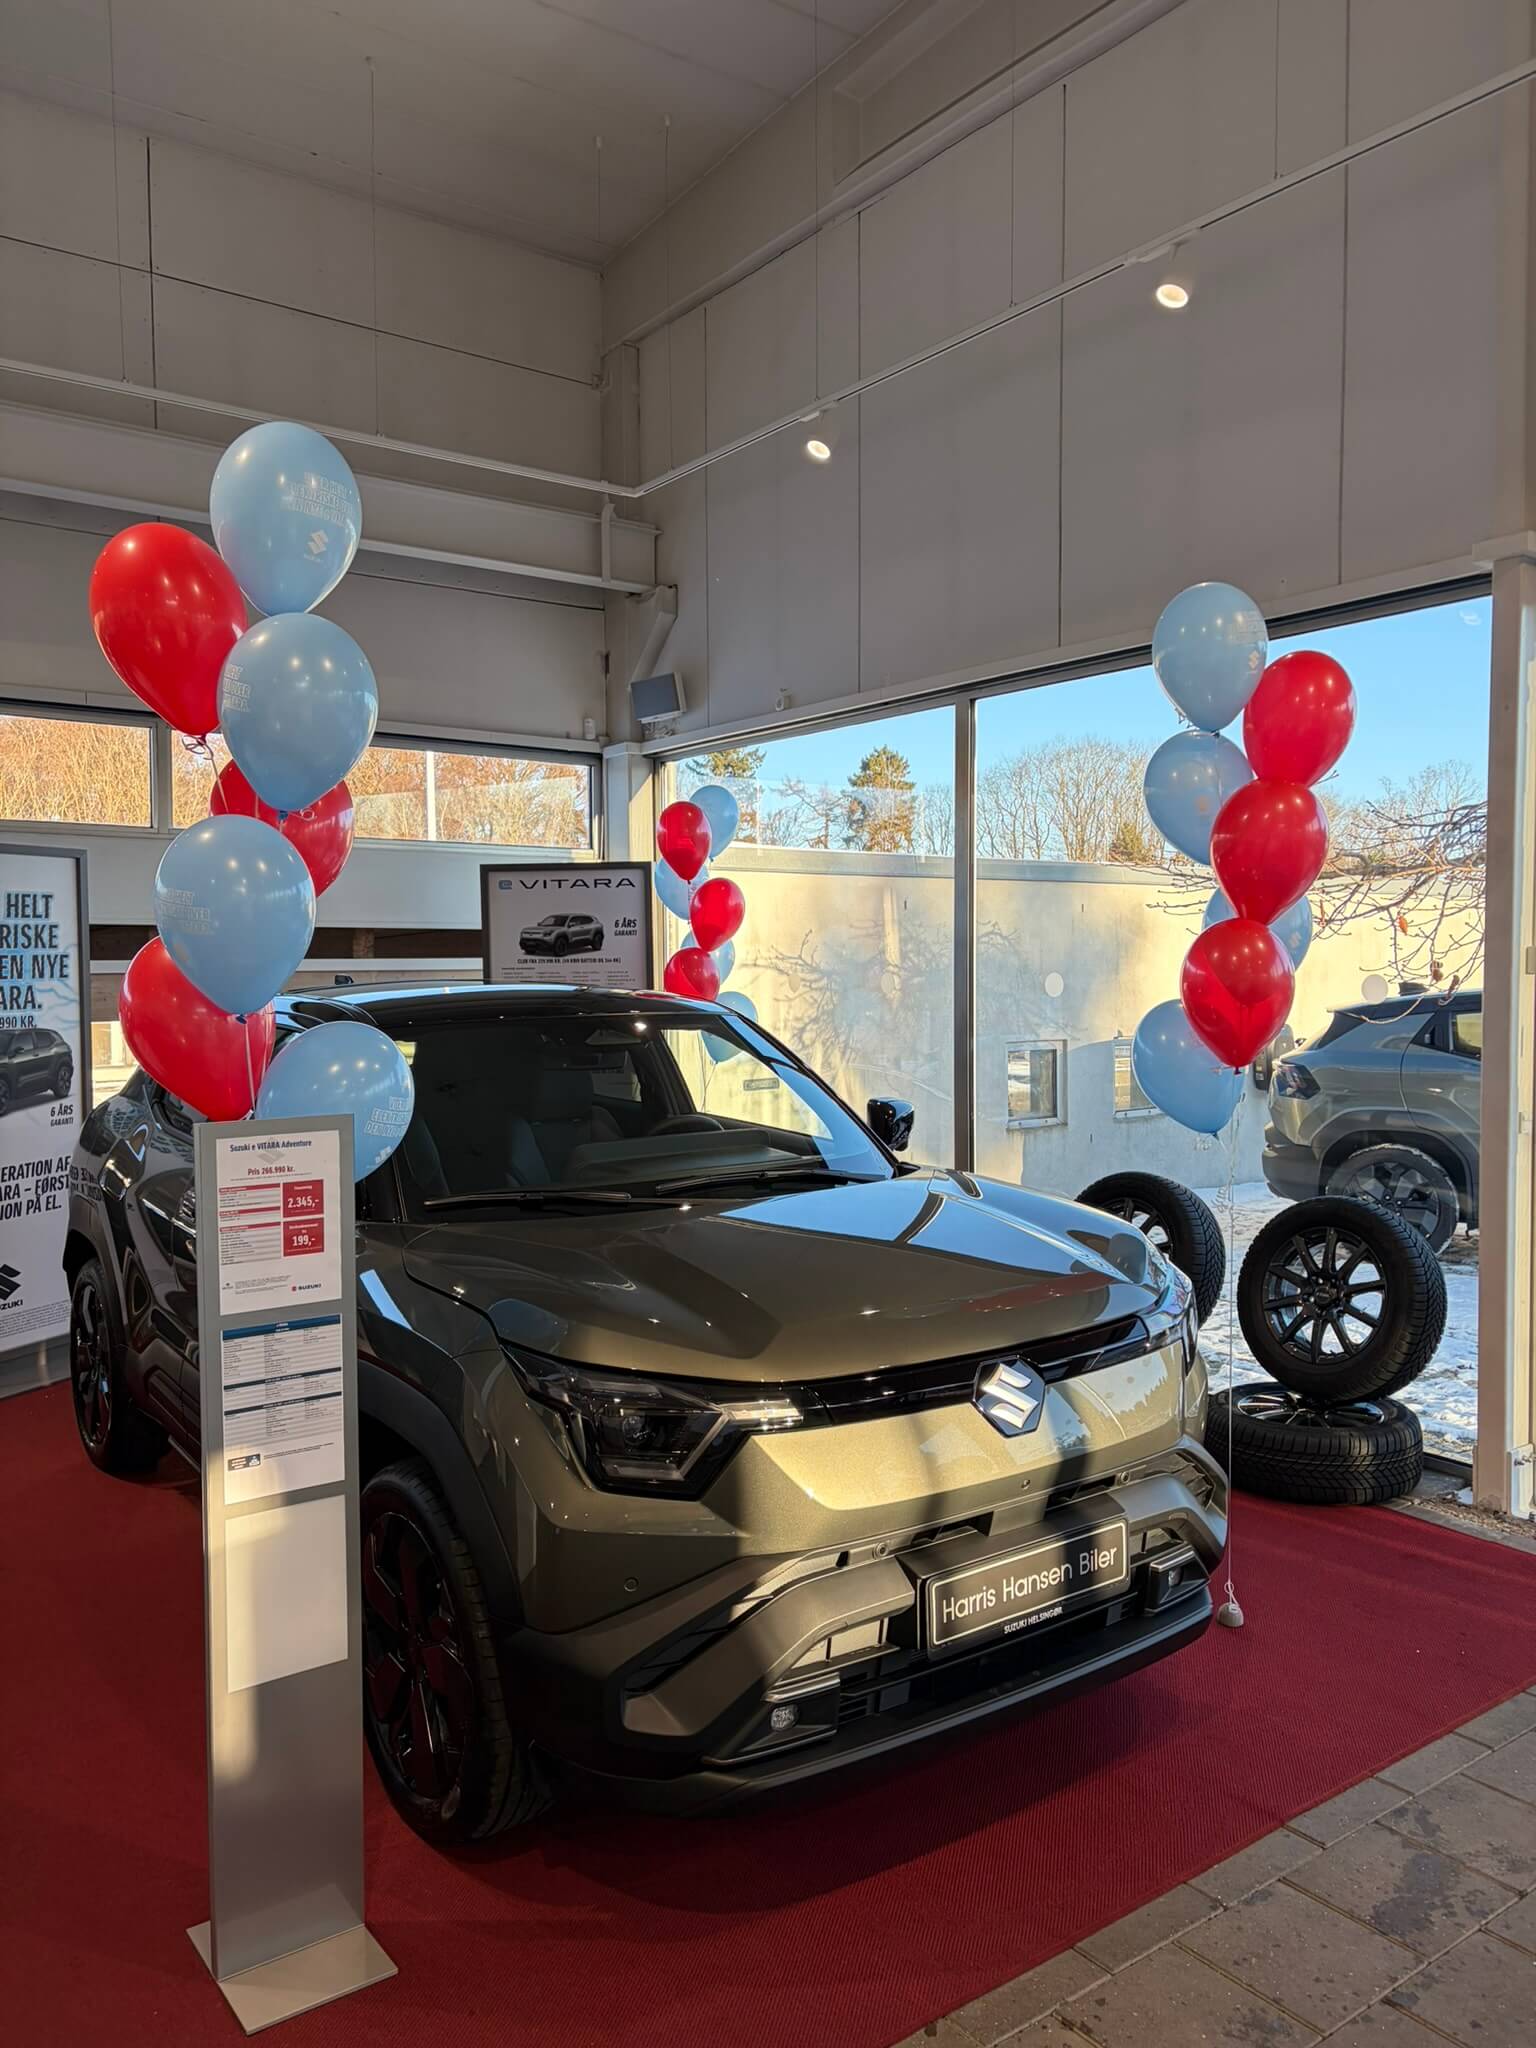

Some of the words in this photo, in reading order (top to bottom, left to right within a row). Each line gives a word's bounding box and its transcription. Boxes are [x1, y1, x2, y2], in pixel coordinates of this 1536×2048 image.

[519, 878, 636, 890] VITARA
[6, 893, 54, 919] HELT
[613, 919, 620, 929] 6
[621, 917, 637, 928] ÅRS
[32, 954, 69, 979] NYE
[50, 1107, 56, 1117] 6
[57, 1103, 74, 1116] ÅRS
[50, 1117, 74, 1127] GARANTI
[229, 1143, 251, 1152] Suzuki
[257, 1141, 280, 1150] VITARA
[281, 1140, 312, 1148] Adventure
[1, 1158, 53, 1183] ERATION
[55, 1155, 72, 1173] AF
[247, 1167, 260, 1176] Pris
[286, 1164, 296, 1173] kr.
[35, 1174, 70, 1196] FØRST
[26, 1194, 42, 1215] PÅ
[45, 1194, 62, 1212] EL.
[292, 1234, 316, 1247] 199,-
[0, 1299, 23, 1311] ZUKI
[943, 1586, 996, 1623] Harris
[1002, 1563, 1073, 1602] Hansen
[1079, 1547, 1117, 1575] Biler
[1003, 1618, 1028, 1634] SUZUKI
